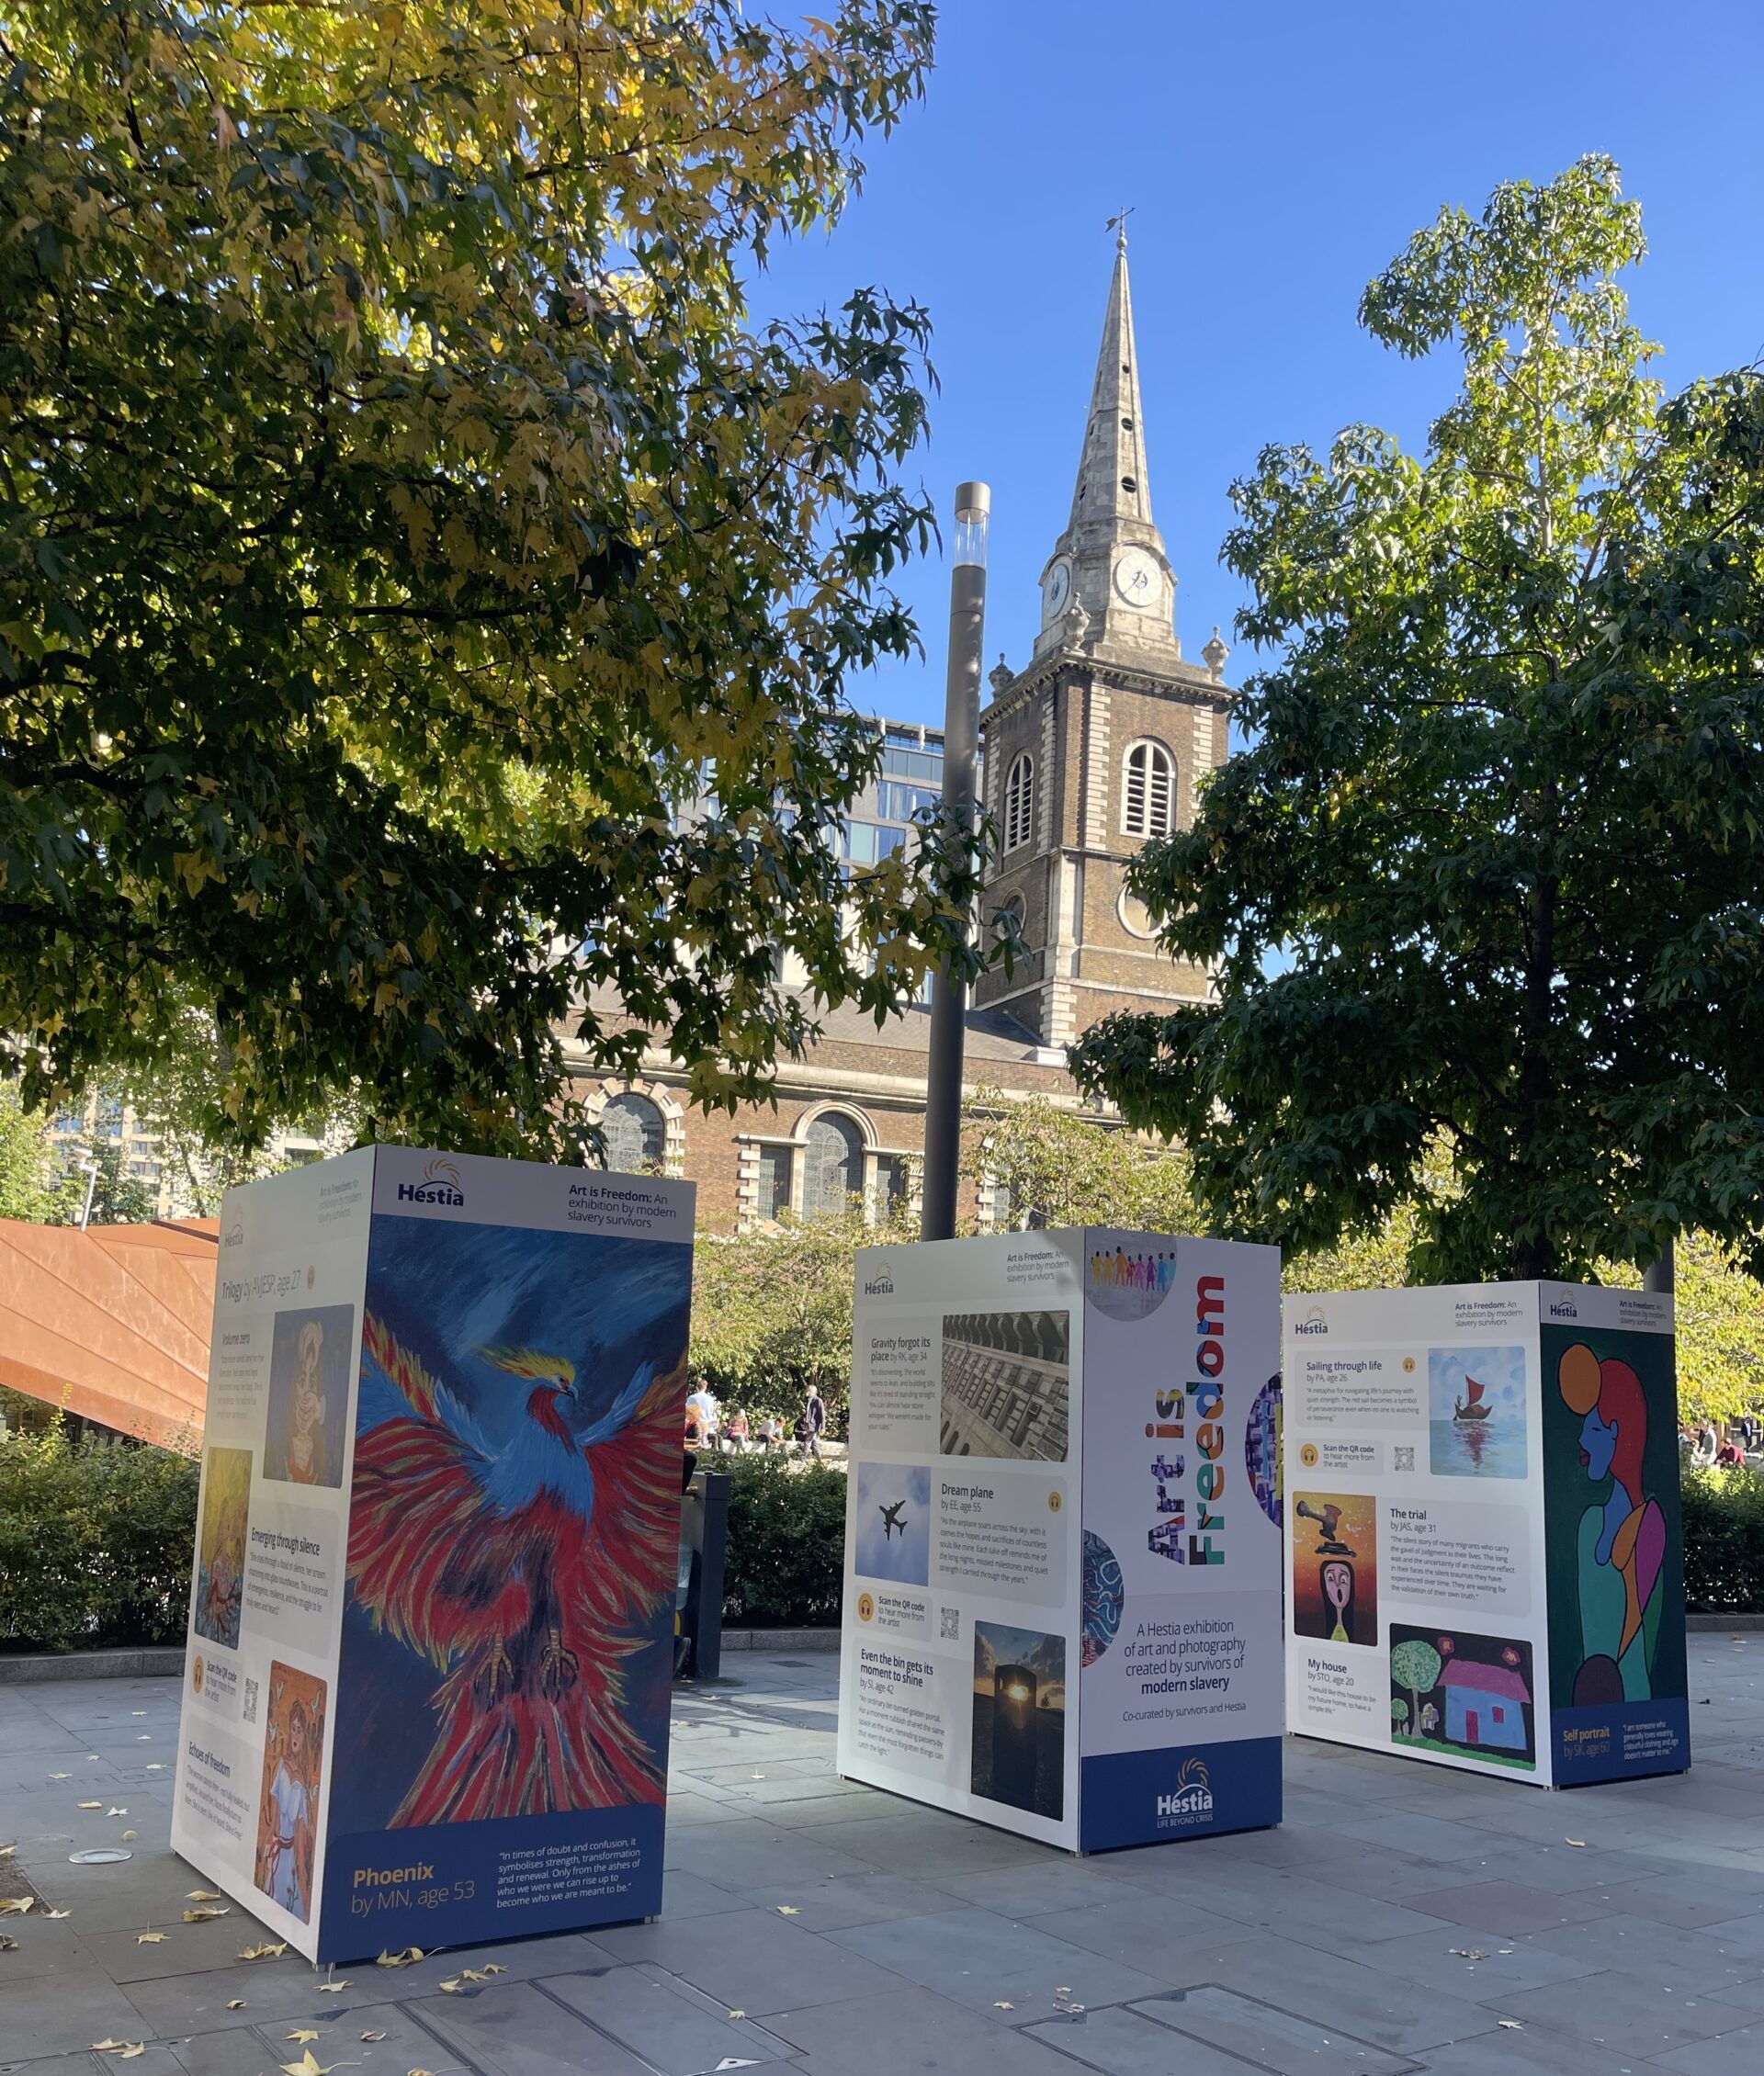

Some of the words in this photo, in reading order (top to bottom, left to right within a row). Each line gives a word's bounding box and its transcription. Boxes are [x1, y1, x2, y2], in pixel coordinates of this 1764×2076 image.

[398, 1183, 464, 1206] Hestia
[570, 1184, 587, 1196] Art
[590, 1186, 598, 1197] is
[601, 1187, 652, 1202] Freedom:
[654, 1192, 668, 1203] An
[568, 1198, 619, 1213] exhibition
[621, 1202, 634, 1216] by
[636, 1205, 676, 1217] modern
[568, 1210, 605, 1226] slavery
[606, 1215, 652, 1227] survivors
[225, 1229, 243, 1247] Hestia
[865, 1281, 893, 1294] Hestia
[1487, 1310, 1495, 1319] by
[1551, 1304, 1577, 1317] Hestia
[1295, 1323, 1328, 1334] Hestia
[1455, 1320, 1477, 1328] slavery
[871, 1337, 897, 1350] Gravity
[898, 1337, 920, 1350] forgot
[921, 1337, 931, 1347] its
[871, 1350, 889, 1363] place
[889, 1350, 897, 1363] by
[908, 1353, 919, 1362] age
[920, 1350, 927, 1360] 34
[1306, 1361, 1332, 1372] Sailing
[1333, 1361, 1367, 1372] through
[1368, 1361, 1382, 1370] life
[1306, 1374, 1314, 1383] by
[1146, 1388, 1184, 1439] is
[1185, 1276, 1225, 1564] Freedom
[942, 1484, 968, 1495] Dream
[970, 1486, 994, 1500] plane
[941, 1498, 949, 1512] by
[959, 1503, 971, 1514] age
[972, 1502, 981, 1512] 55
[1148, 1455, 1184, 1564] Art
[1390, 1508, 1407, 1518] The
[1408, 1510, 1427, 1519] trial
[1391, 1521, 1399, 1531] by
[1413, 1525, 1426, 1533] age
[1428, 1524, 1436, 1532] 31
[252, 1528, 276, 1550] Emerging
[277, 1532, 299, 1554] through
[300, 1538, 320, 1556] silence
[878, 1596, 891, 1605] Scan
[891, 1597, 901, 1607] the
[901, 1599, 910, 1608] QR
[910, 1602, 925, 1611] code
[1136, 1623, 1145, 1636] A
[1148, 1622, 1180, 1636] Hestia
[1183, 1620, 1234, 1634] exhibition
[1125, 1643, 1136, 1656] of
[1137, 1642, 1153, 1655] art
[1155, 1642, 1176, 1654] and
[1179, 1638, 1246, 1657] photography
[861, 1648, 878, 1662] Even
[879, 1653, 891, 1665] the
[893, 1655, 905, 1668] bin
[906, 1660, 922, 1673] gets
[923, 1662, 933, 1675] its
[1126, 1660, 1167, 1675] created
[1170, 1659, 1182, 1675] by
[1184, 1657, 1231, 1672] survivors
[1233, 1654, 1246, 1668] of
[1308, 1659, 1320, 1671] My
[1322, 1661, 1347, 1673] house
[861, 1665, 891, 1679] moment
[893, 1670, 900, 1682] to
[902, 1673, 923, 1687] shine
[1142, 1679, 1187, 1694] modern
[1190, 1675, 1229, 1692] slavery
[1308, 1671, 1316, 1681] by
[1317, 1672, 1331, 1683] STO,
[1332, 1677, 1344, 1686] age
[1346, 1677, 1354, 1686] 20
[860, 1677, 867, 1689] by
[876, 1684, 886, 1694] age
[887, 1685, 894, 1694] 42
[1123, 1708, 1163, 1721] Co-curated
[1165, 1707, 1174, 1720] by
[1175, 1705, 1207, 1716] survivors
[1209, 1703, 1223, 1713] and
[1224, 1701, 1247, 1712] Hestia
[1564, 1729, 1578, 1742] Self
[1580, 1726, 1610, 1743] portrait
[189, 1742, 203, 1762] Echoes
[204, 1752, 209, 1766] of
[210, 1753, 230, 1778] freedom
[1158, 1791, 1213, 1815] Hestia
[1158, 1819, 1169, 1827] LIFE
[1170, 1815, 1194, 1826] BEYOND
[1195, 1812, 1213, 1822] CRISIS
[512, 1850, 535, 1859] times
[537, 1847, 546, 1856] of
[546, 1845, 571, 1856] doubt
[572, 1843, 588, 1852] and
[589, 1839, 629, 1850] confusion,
[630, 1837, 637, 1846] it
[498, 1859, 543, 1873] symbolises
[545, 1855, 581, 1867] strength,
[582, 1848, 640, 1863] transformation
[354, 1863, 434, 1888] Phoenix
[498, 1873, 514, 1883] and
[515, 1869, 549, 1881] renewal.
[552, 1867, 571, 1879] Only
[572, 1866, 592, 1875] from
[594, 1863, 606, 1873] the
[608, 1861, 630, 1871] ashes
[631, 1858, 641, 1868] of
[498, 1885, 515, 1895] who
[516, 1885, 529, 1893] we
[530, 1883, 551, 1891] were
[566, 1879, 581, 1888] can
[582, 1877, 596, 1886] rise
[598, 1876, 608, 1886] up
[610, 1873, 619, 1882] to
[352, 1894, 375, 1917] by
[378, 1890, 413, 1911] MN,
[418, 1889, 448, 1909] age
[454, 1881, 474, 1900] 53
[496, 1898, 529, 1908] become
[531, 1893, 549, 1903] who
[550, 1893, 562, 1901] we
[579, 1887, 605, 1898] meant
[606, 1886, 615, 1895] to
